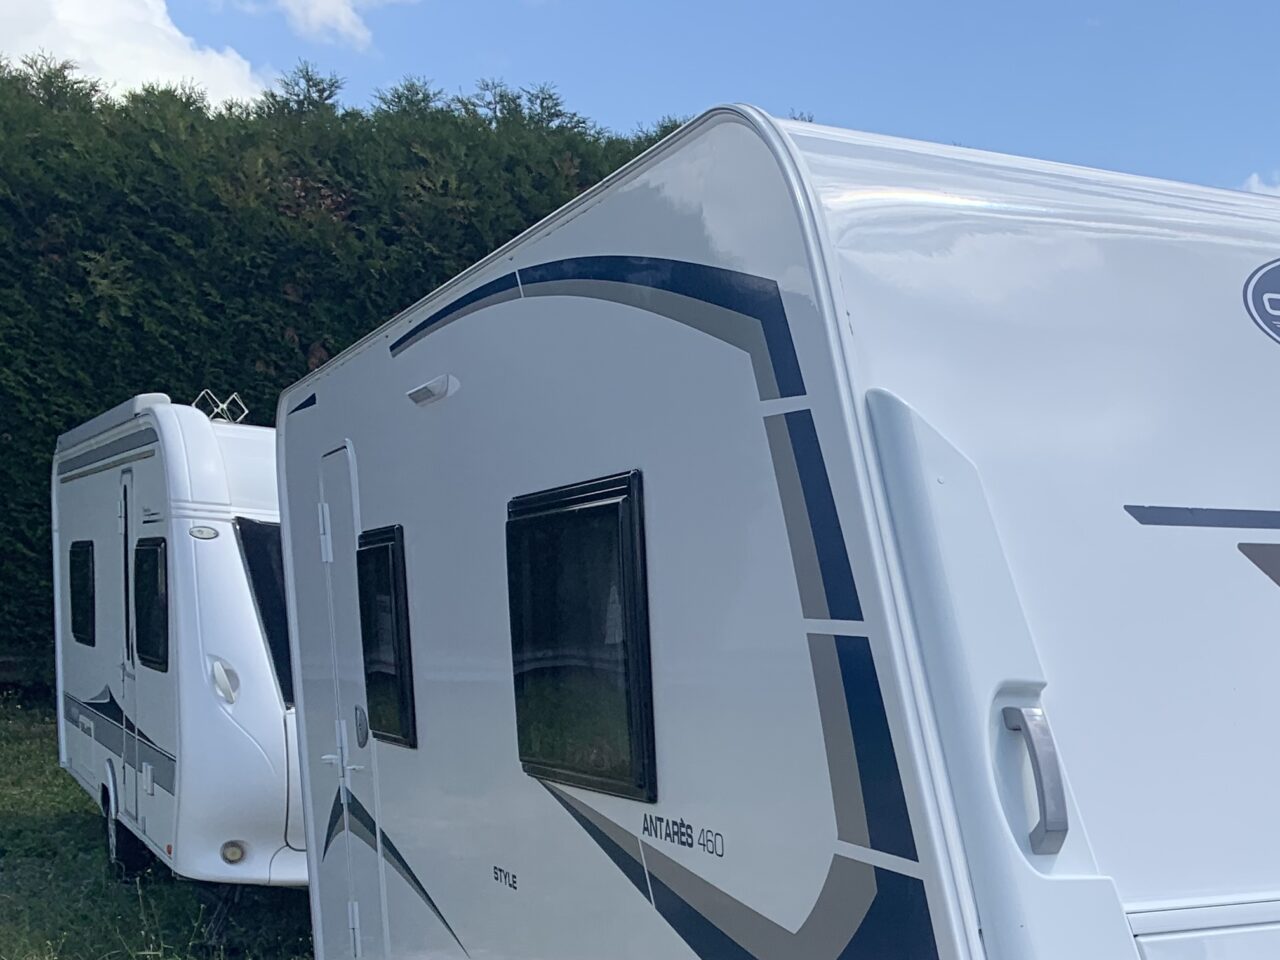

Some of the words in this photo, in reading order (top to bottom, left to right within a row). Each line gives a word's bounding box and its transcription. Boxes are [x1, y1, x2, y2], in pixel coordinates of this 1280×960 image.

[642, 813, 694, 848] ANTARÈS
[697, 828, 724, 857] 460
[493, 865, 518, 890] STYLE
